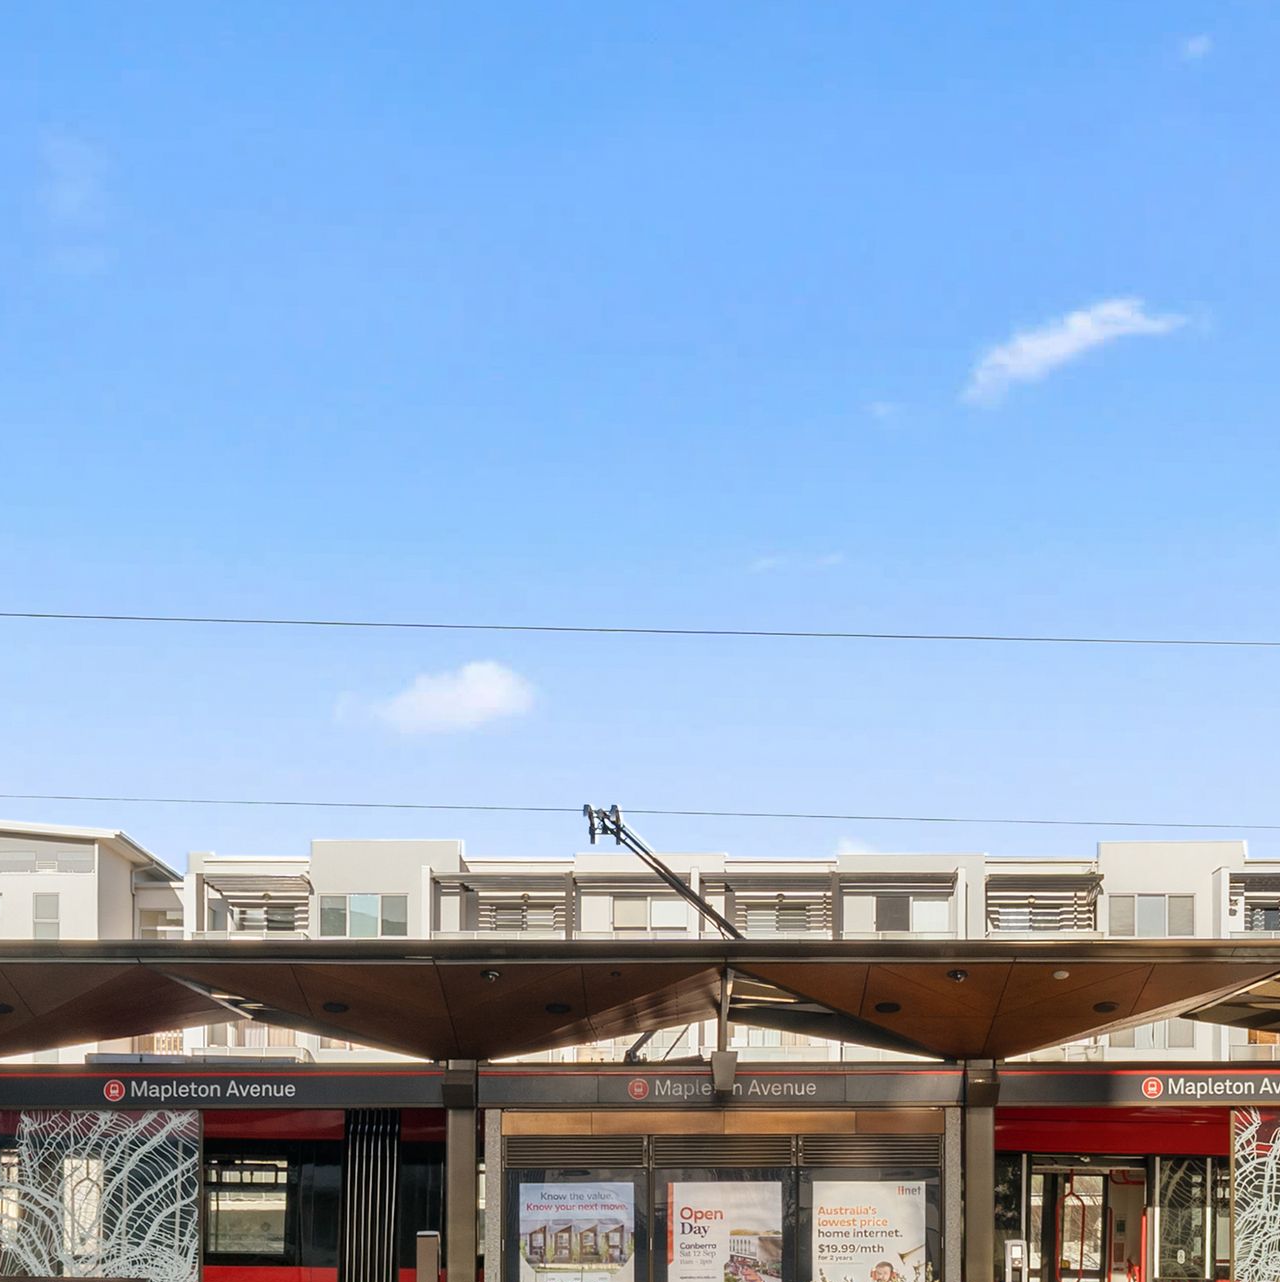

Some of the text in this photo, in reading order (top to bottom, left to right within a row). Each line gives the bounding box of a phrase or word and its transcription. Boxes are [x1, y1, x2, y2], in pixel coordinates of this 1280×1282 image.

[130, 1080, 296, 1101] Mapleton Avenue
[654, 1079, 817, 1099] Maplen Avenue
[1168, 1077, 1255, 1098] Mapleton
[540, 1192, 567, 1200] Know
[569, 1191, 585, 1200] the
[526, 1202, 552, 1211] Know
[554, 1204, 575, 1213] your
[578, 1203, 598, 1211] next
[818, 1206, 877, 1215] Australia's
[680, 1207, 724, 1224] Open
[818, 1218, 888, 1229] lowest price
[680, 1222, 710, 1238] Day
[818, 1229, 903, 1238] home internet.
[679, 1242, 717, 1250] Canberra
[818, 1244, 885, 1253] $19.99/mth
